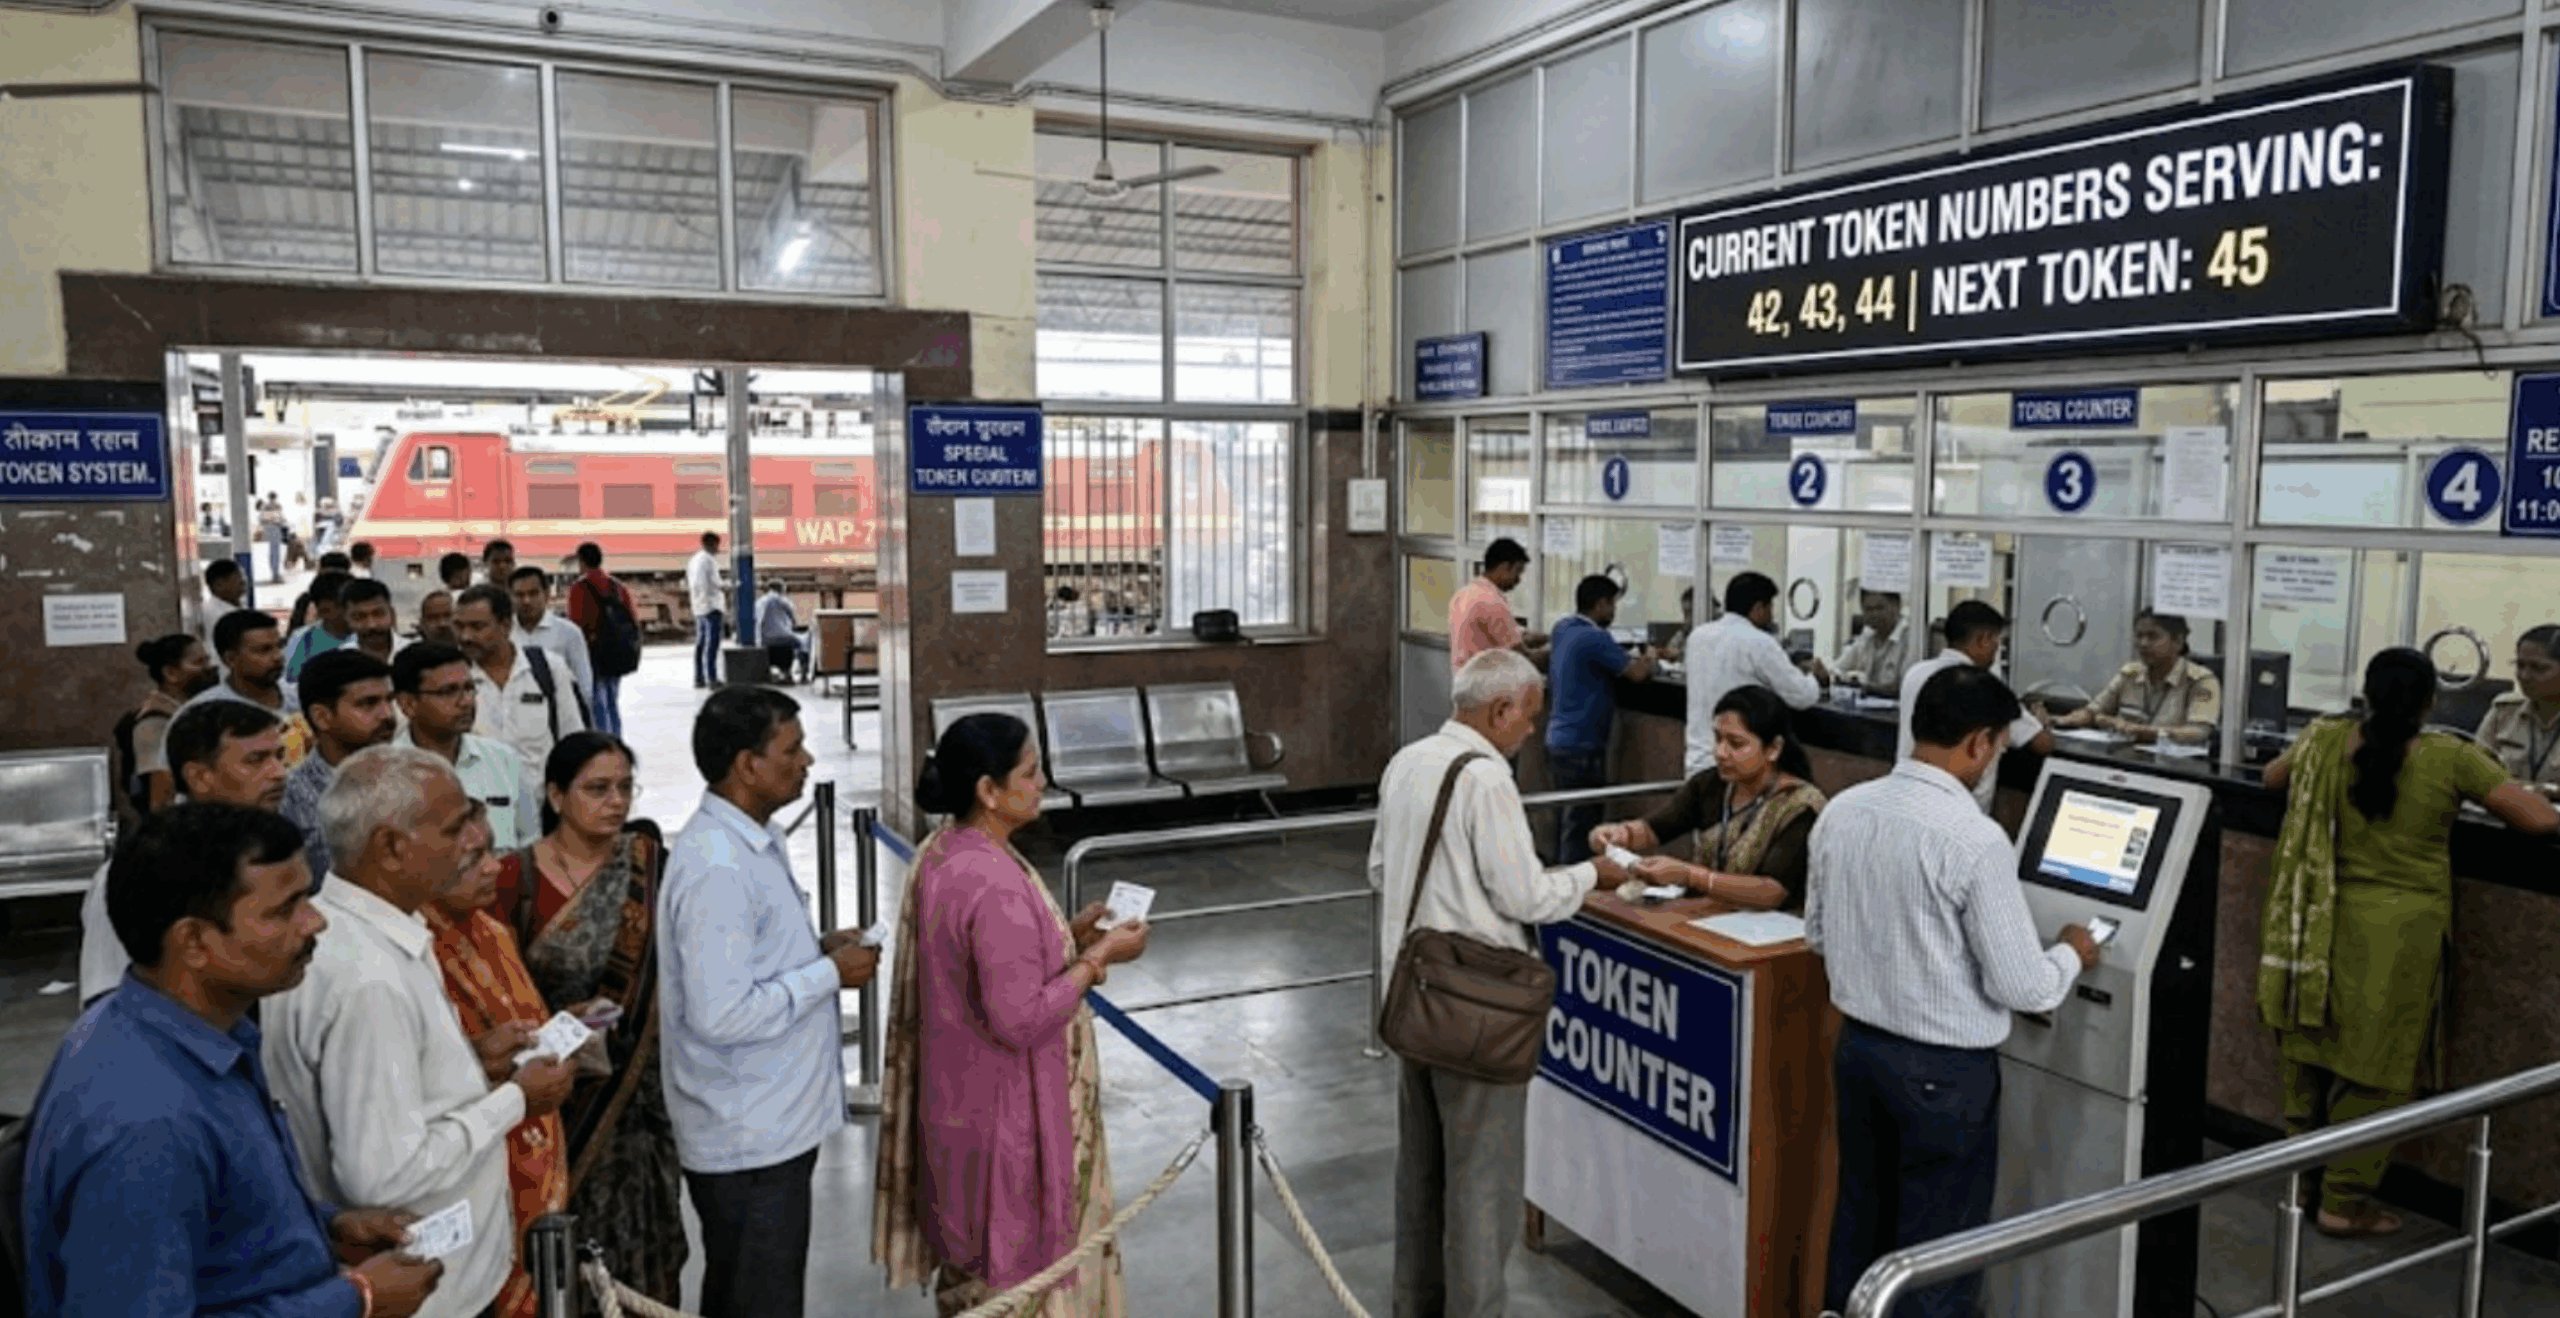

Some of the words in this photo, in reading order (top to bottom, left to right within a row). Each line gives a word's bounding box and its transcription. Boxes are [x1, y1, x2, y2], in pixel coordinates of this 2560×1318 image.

[1688, 218, 1815, 282] CURRENT
[1823, 199, 1929, 262] TOKEN
[1938, 161, 2131, 244] NUMBERS
[2144, 121, 2385, 213] SERVING:
[1747, 287, 1790, 339] 42,
[1799, 281, 1846, 333] 43,
[1855, 275, 1896, 322] 44
[1930, 256, 2032, 318] NEXT
[2040, 244, 2194, 306] TOKEN:
[2206, 226, 2270, 288] 45
[2018, 401, 2061, 421] TOKEN
[2065, 397, 2132, 420] COUNTER
[2527, 427, 2560, 453] RE
[1608, 460, 1622, 494] 1
[1798, 461, 1818, 498] 2
[2056, 460, 2083, 504] 3
[2441, 460, 2482, 512] 4
[1558, 937, 1679, 1042] TOKEN
[1546, 1006, 1716, 1142] COUNTER
